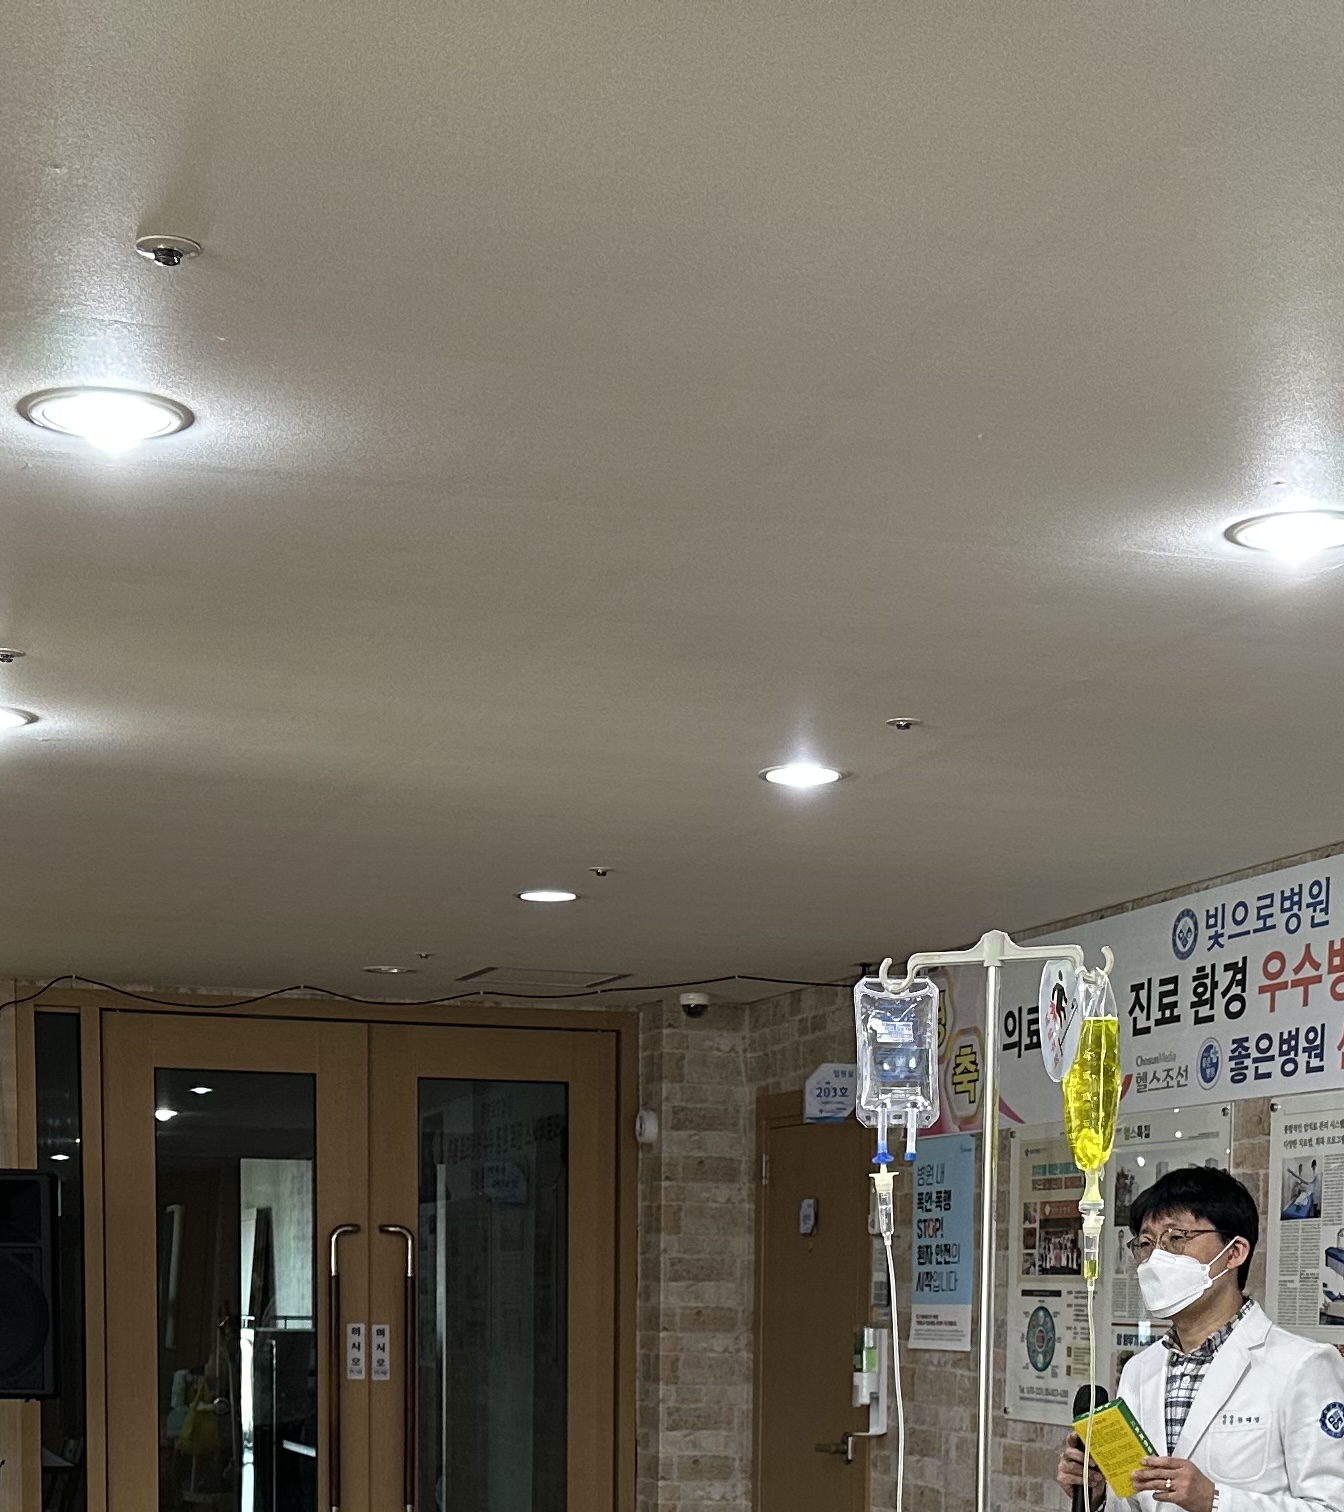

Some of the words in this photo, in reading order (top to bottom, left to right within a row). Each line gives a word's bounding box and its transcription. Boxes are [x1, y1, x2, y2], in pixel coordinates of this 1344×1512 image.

[1206, 876, 1331, 952] 빛으로병원
[1128, 976, 1181, 1037] 진료
[1190, 956, 1248, 1026] 환경
[1228, 1024, 1325, 1084] 좋은병원
[1136, 1065, 1188, 1093] 헬스조선
[816, 1086, 848, 1098] 203호
[918, 1164, 933, 1186] 병원
[936, 1163, 945, 1184] 내
[917, 1217, 944, 1239] STOP!
[918, 1244, 933, 1265] 환자
[936, 1243, 960, 1265] 안전의
[916, 1271, 958, 1292] 시작입니다
